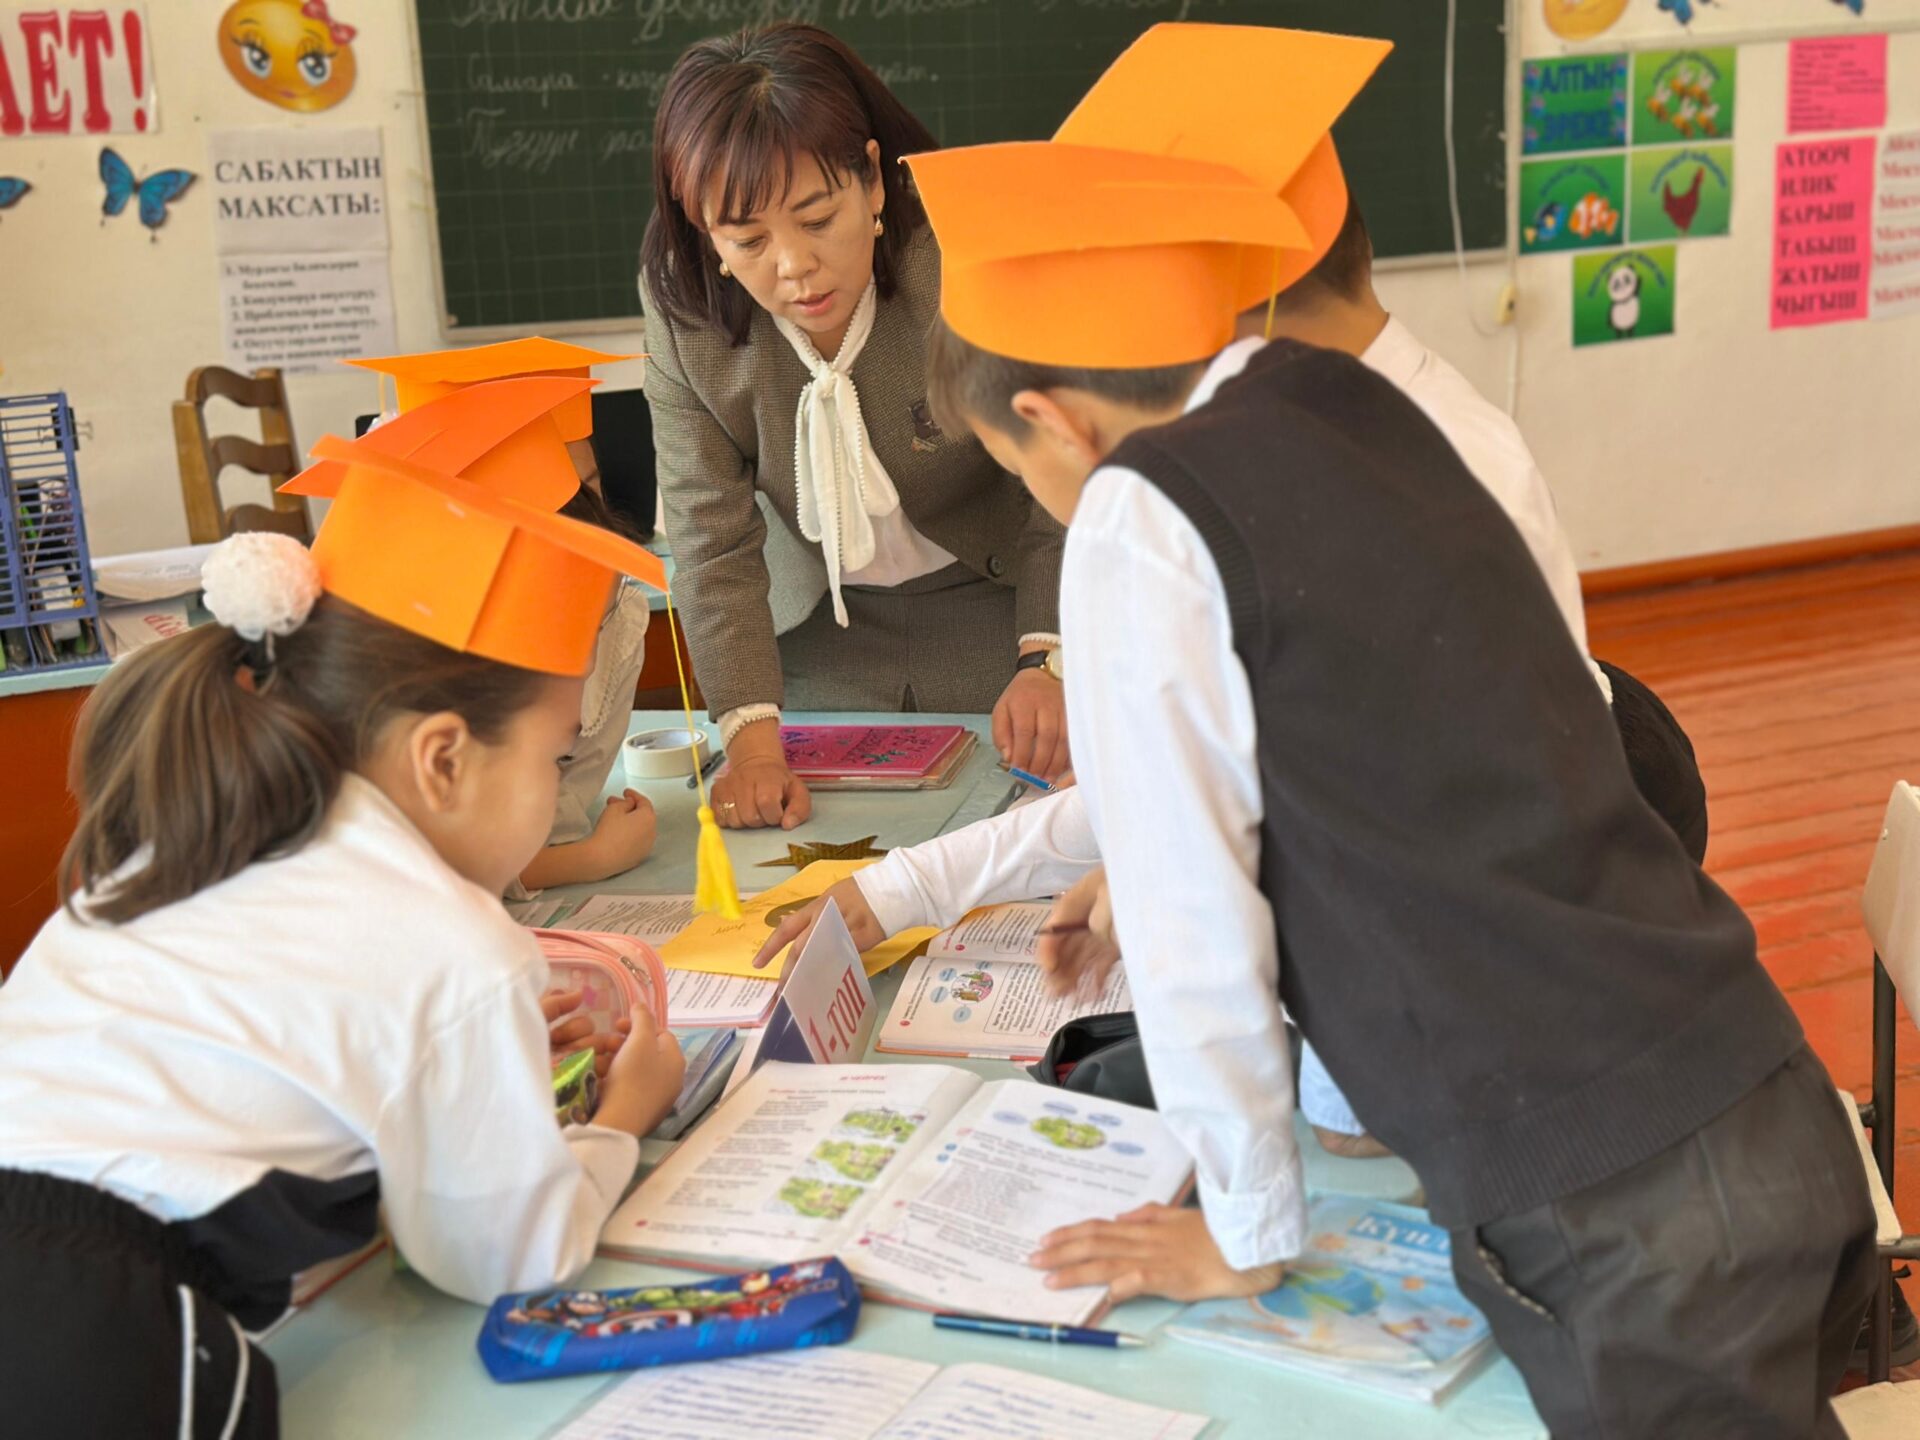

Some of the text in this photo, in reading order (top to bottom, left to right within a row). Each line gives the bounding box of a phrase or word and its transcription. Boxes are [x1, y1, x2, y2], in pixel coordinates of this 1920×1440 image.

[1782, 145, 1851, 167] АТООЧ
[215, 156, 382, 184] САБАКТЫН
[1781, 175, 1838, 197] ИЛИК
[218, 192, 381, 219] МАКСАТЫ:
[1779, 202, 1855, 226] БАРЫШ
[1779, 235, 1857, 258] ТАБЫШ
[1777, 262, 1861, 286] ЖАТЫШ
[1775, 289, 1858, 315] ЧЫГЫШ
